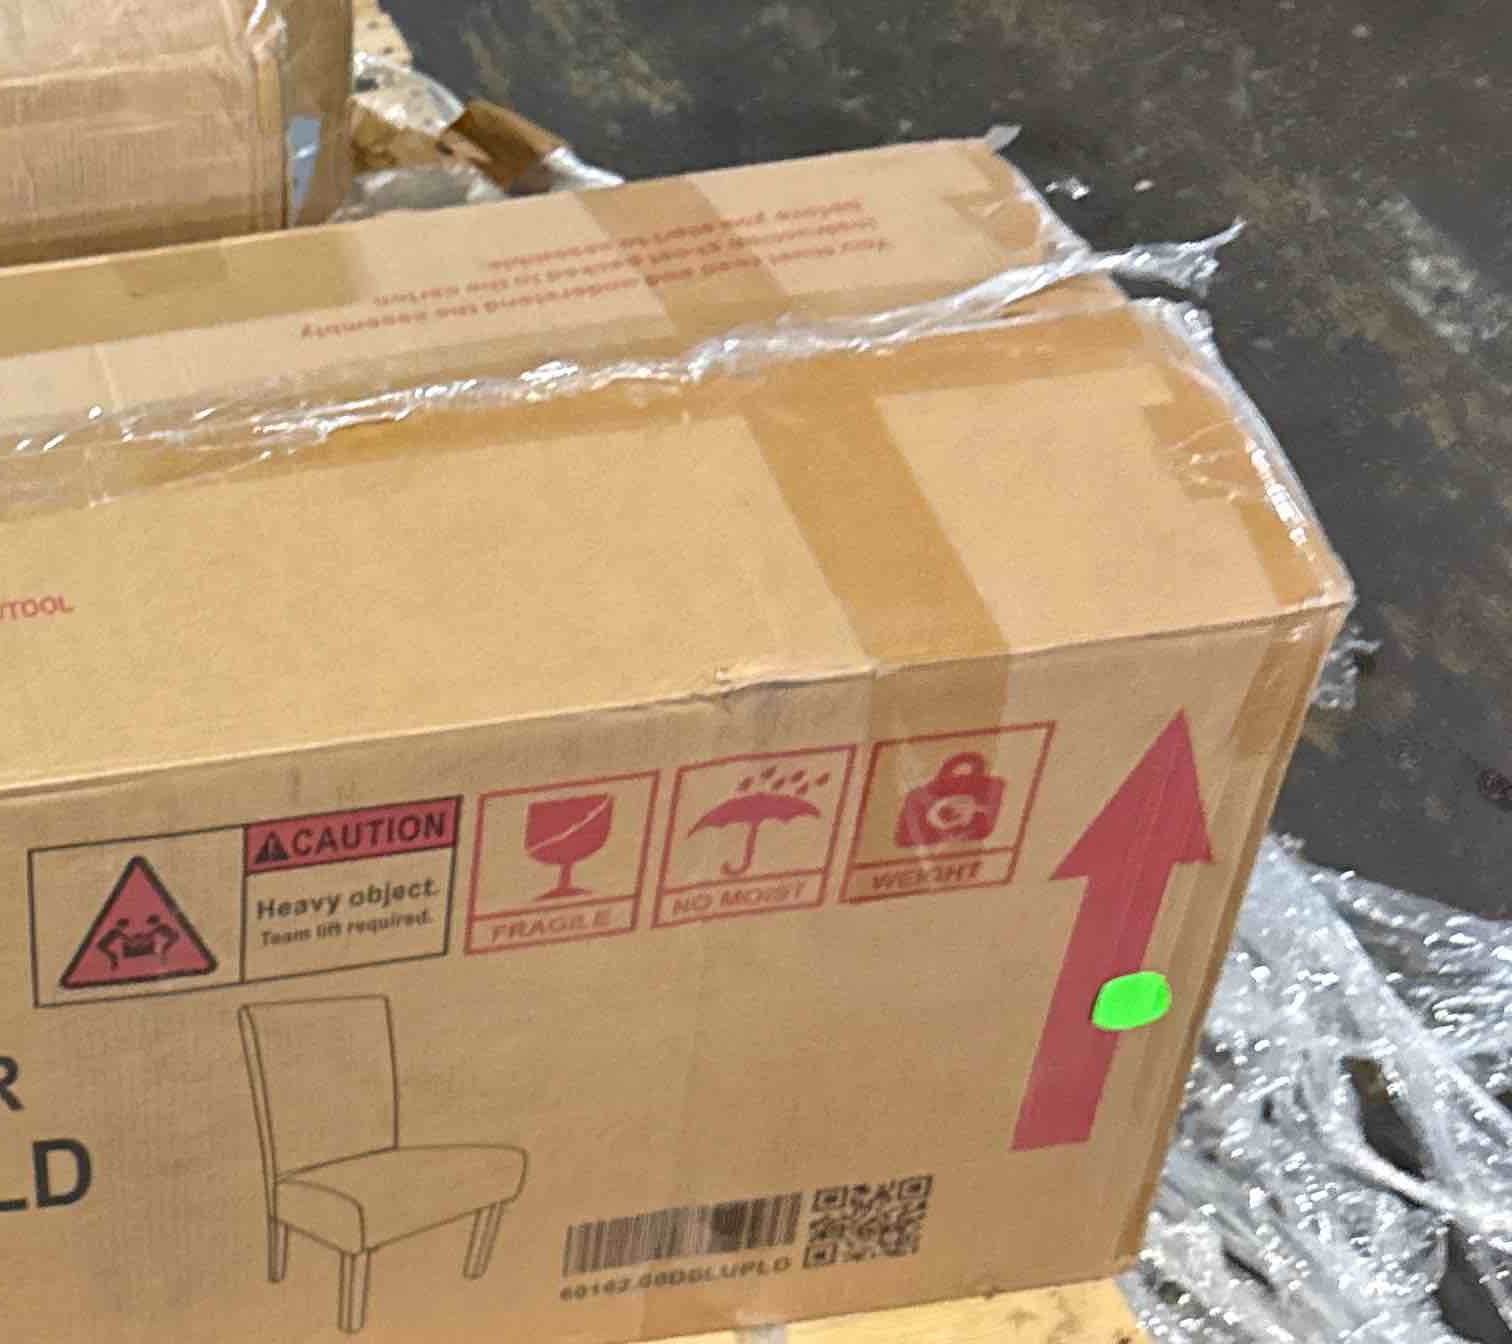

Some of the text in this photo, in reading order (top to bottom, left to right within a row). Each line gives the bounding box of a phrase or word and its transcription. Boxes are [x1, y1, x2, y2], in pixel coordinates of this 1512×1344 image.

[374, 283, 461, 306] carton
[467, 277, 510, 294] the
[484, 276, 642, 314] understand
[300, 309, 429, 338] assembly
[436, 303, 478, 318] the
[291, 812, 446, 857] CAUTION
[870, 860, 984, 894] WEIGHT
[257, 892, 341, 921] Heavy
[673, 879, 807, 917] NO MOIST
[261, 927, 312, 946] Team
[316, 920, 343, 939] lift
[491, 907, 614, 944] FRAGILE
